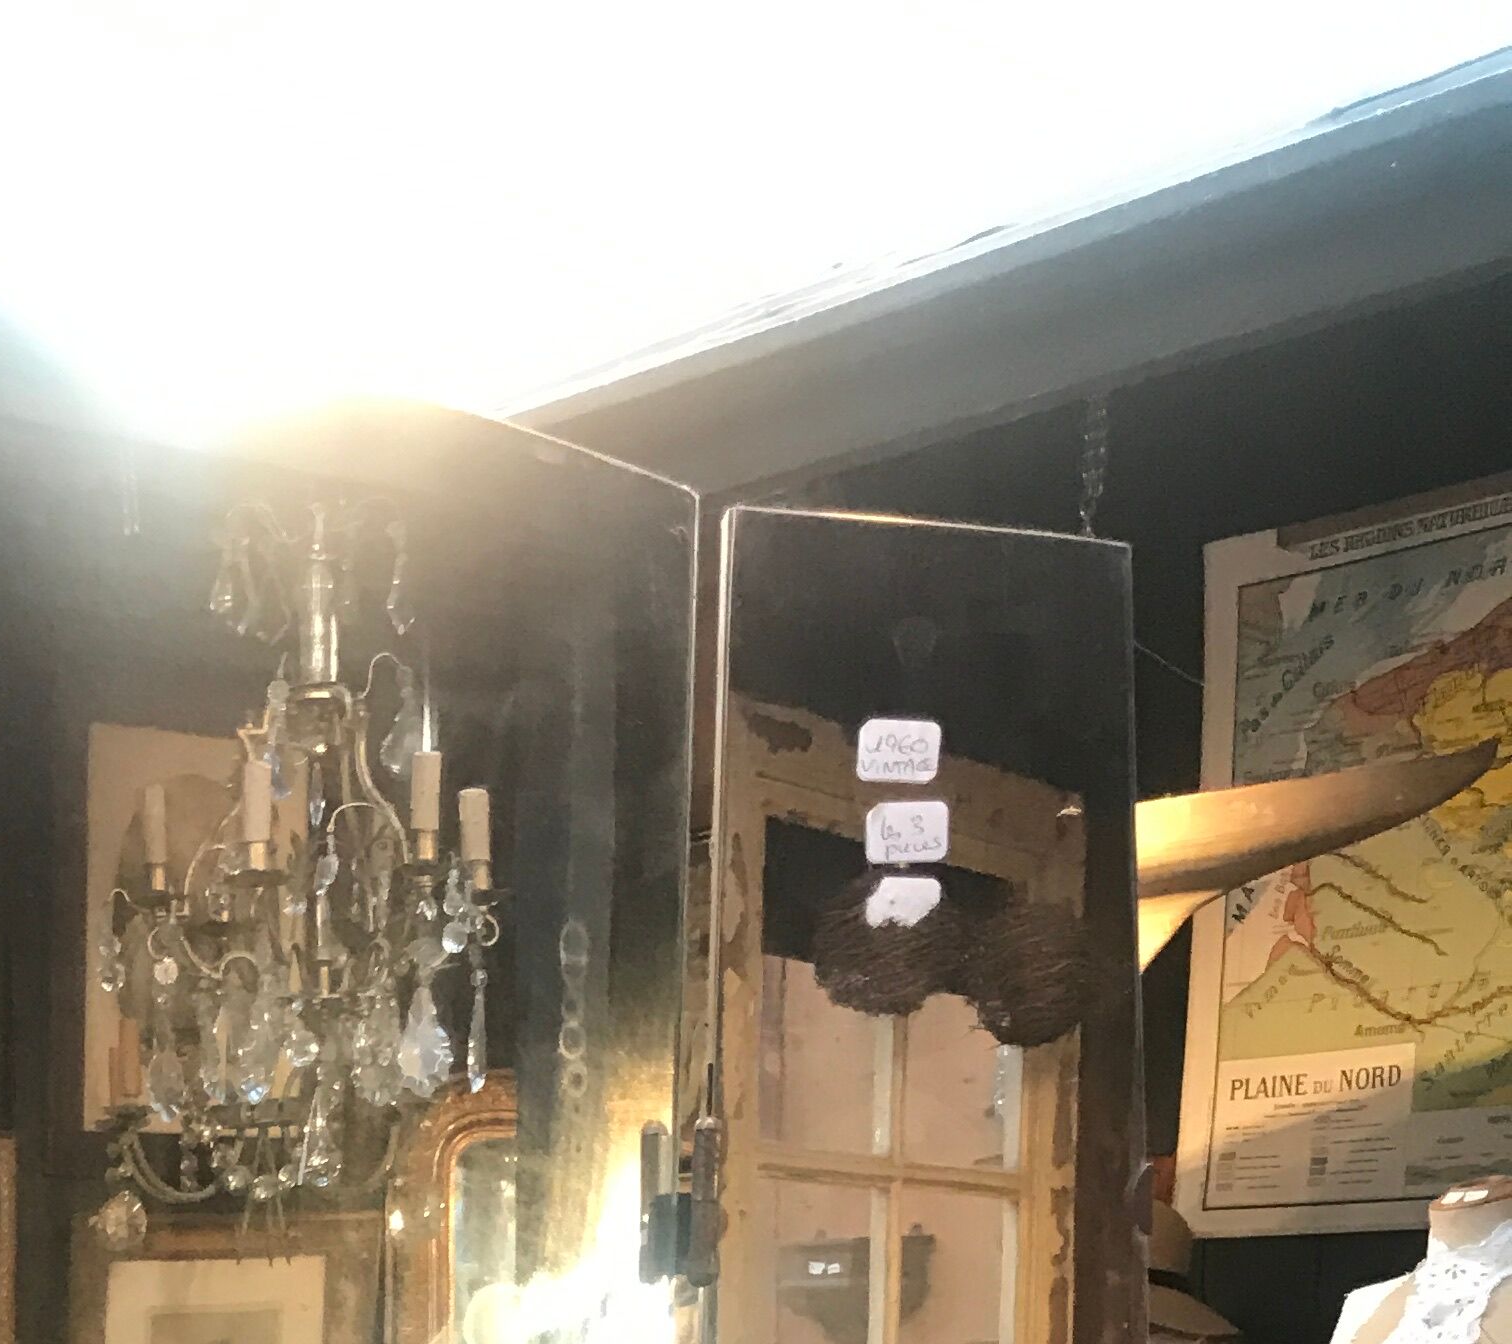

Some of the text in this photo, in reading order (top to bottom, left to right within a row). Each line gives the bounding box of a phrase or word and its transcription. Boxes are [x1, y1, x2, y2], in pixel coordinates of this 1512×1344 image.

[1308, 539, 1341, 560] LES
[1307, 590, 1368, 622] MER
[1229, 1064, 1402, 1101] PLAINE DU NORD
